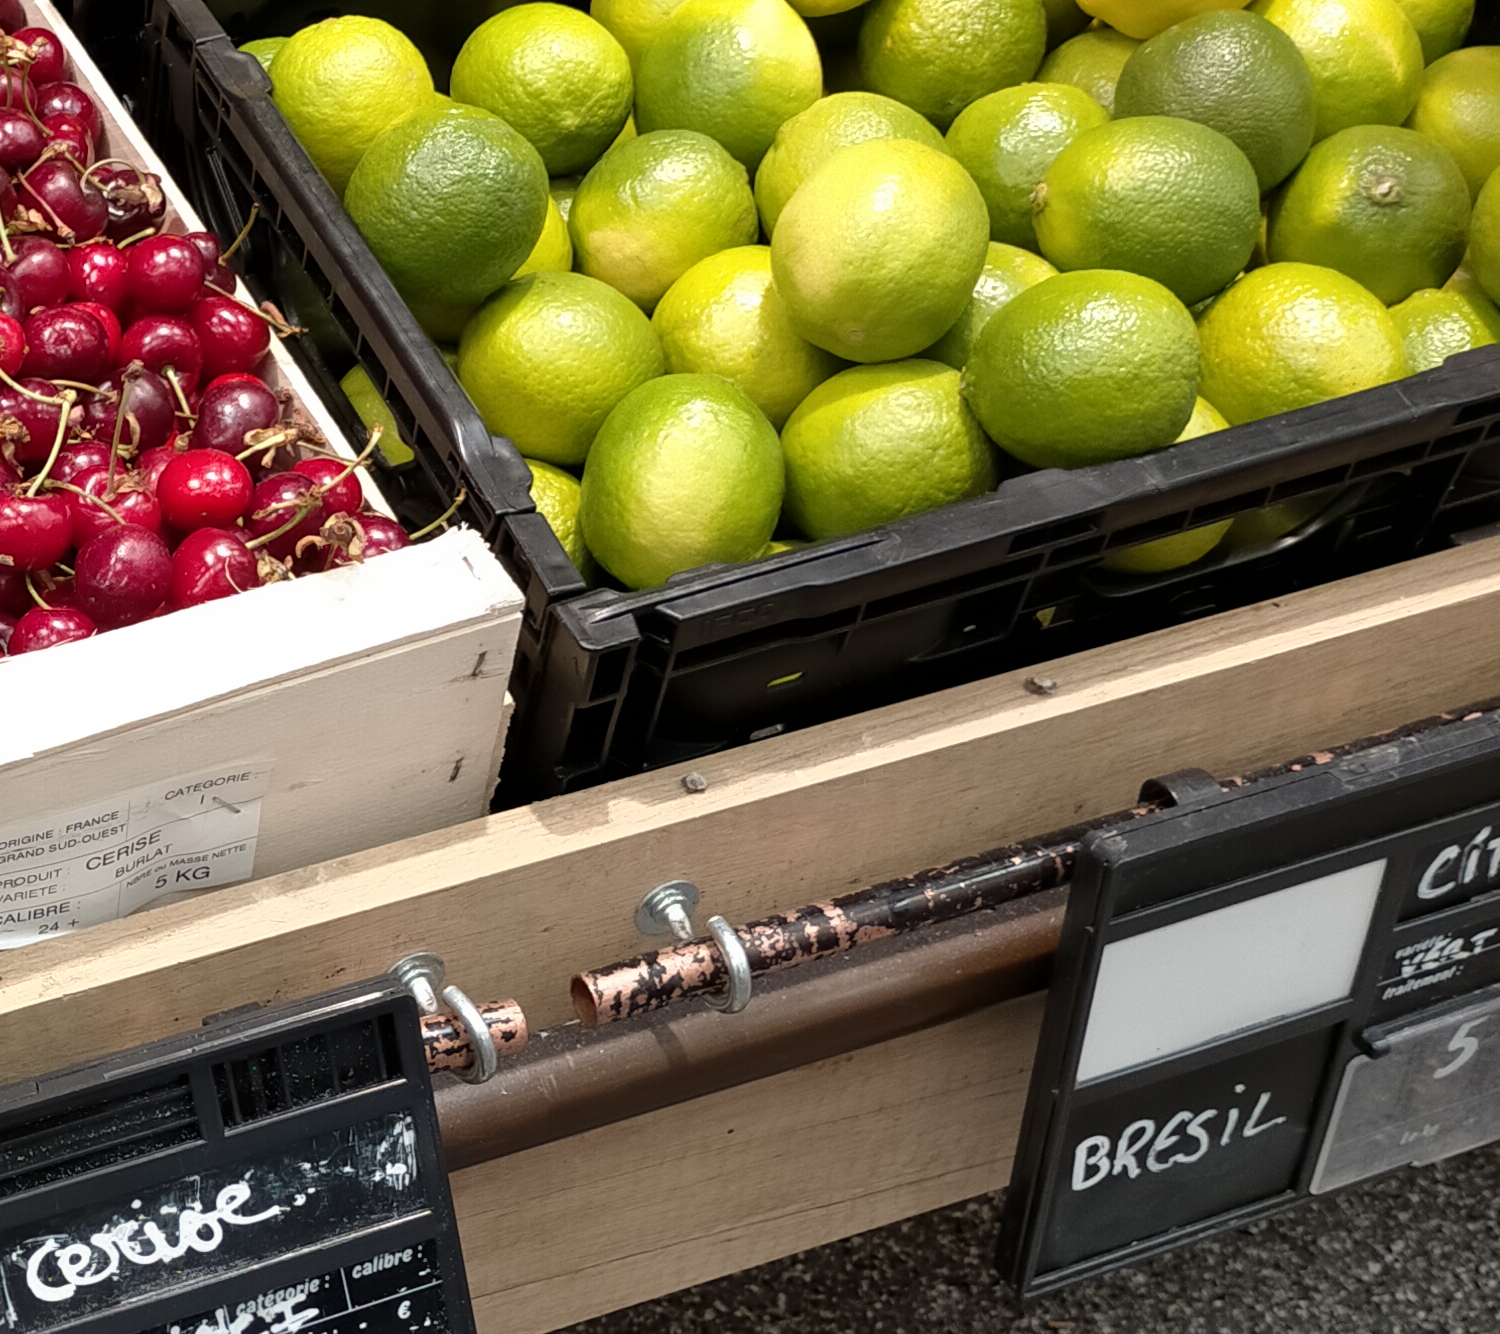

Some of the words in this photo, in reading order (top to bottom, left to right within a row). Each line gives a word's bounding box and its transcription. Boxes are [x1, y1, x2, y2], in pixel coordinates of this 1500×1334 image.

[165, 771, 252, 801] CATEGORIE
[65, 810, 119, 834] FRANCE
[48, 823, 127, 853] SUD-OUEST
[86, 829, 162, 871] CERISE
[115, 843, 173, 879] BURLAT
[169, 852, 209, 867] MASSE
[211, 843, 248, 860] NETTE
[154, 873, 168, 889] 5
[175, 866, 212, 884] KG
[38, 921, 60, 935] 24
[1433, 1015, 1490, 1079] 5
[351, 1249, 413, 1280] calibre
